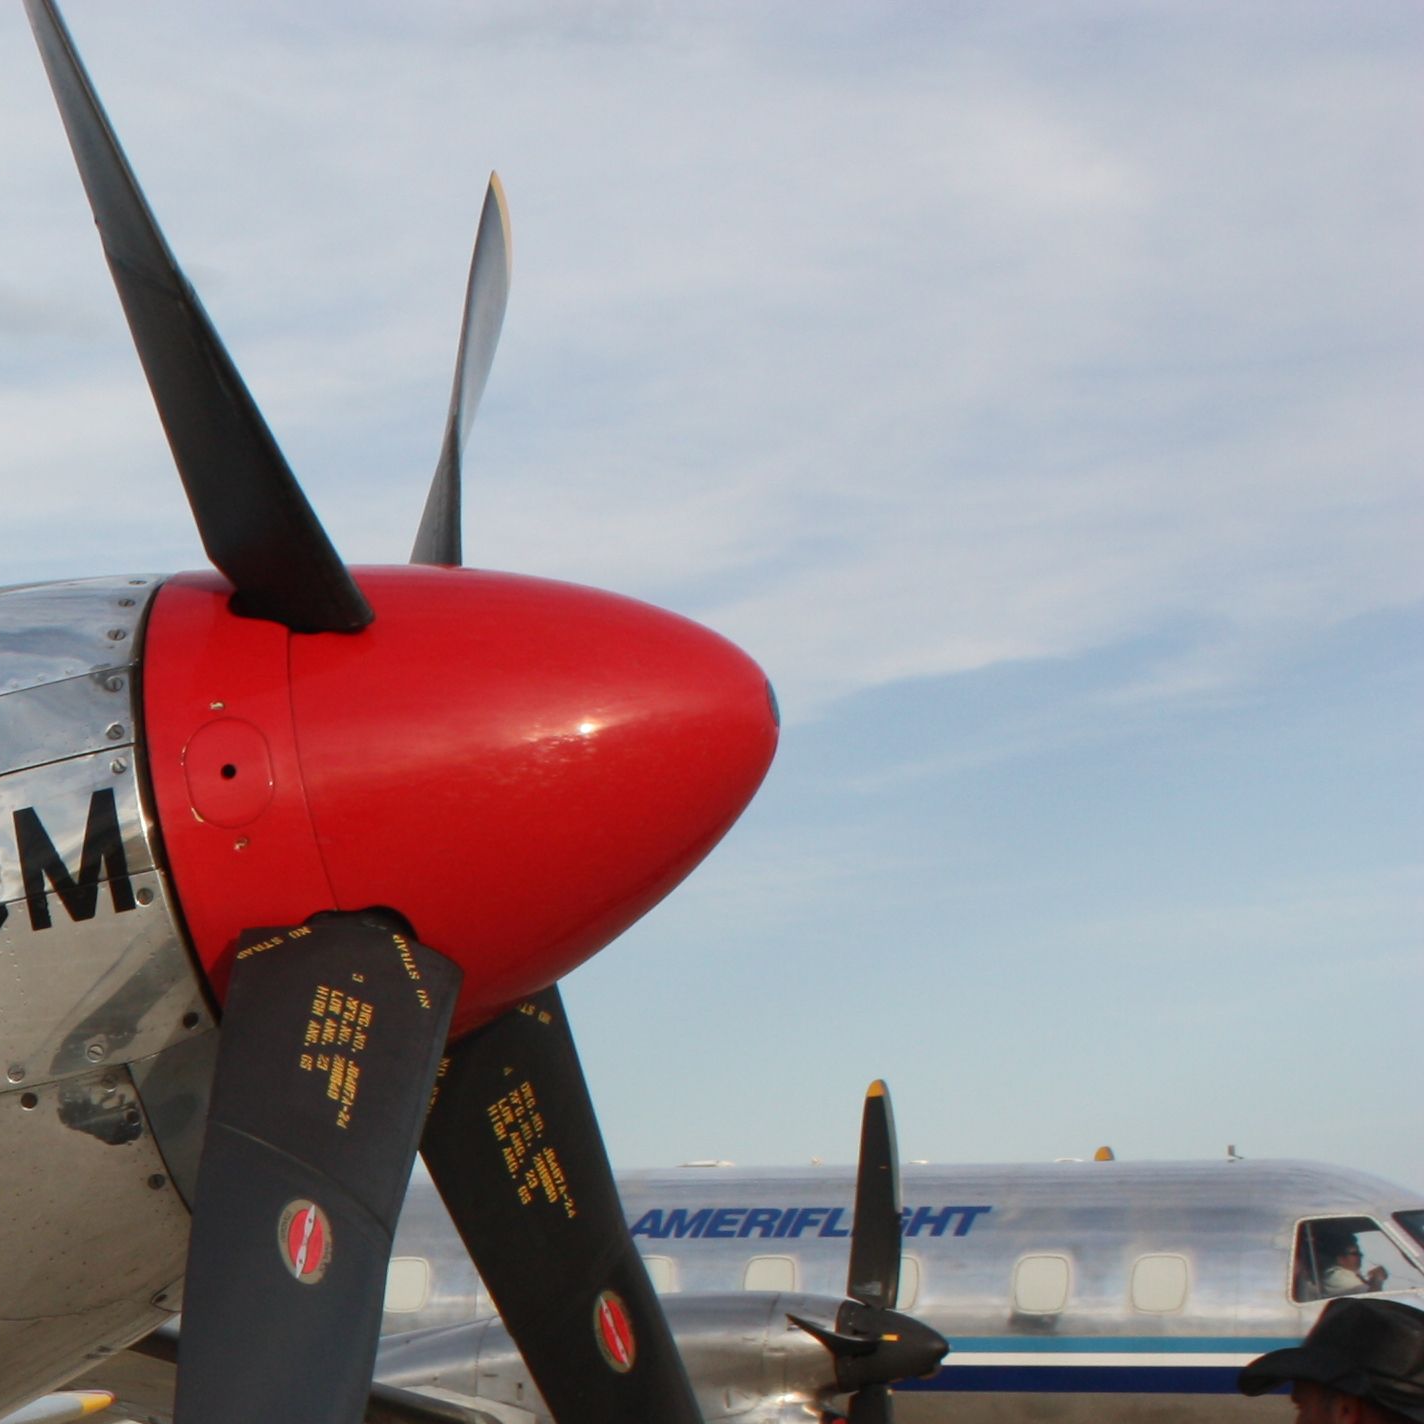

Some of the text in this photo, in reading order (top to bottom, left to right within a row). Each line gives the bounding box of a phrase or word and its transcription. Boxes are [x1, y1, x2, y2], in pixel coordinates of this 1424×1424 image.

[417, 990, 430, 1008] NO
[316, 1054, 329, 1071] 23
[526, 1170, 538, 1188] 23
[631, 1205, 993, 1239] AMERIFLHT
